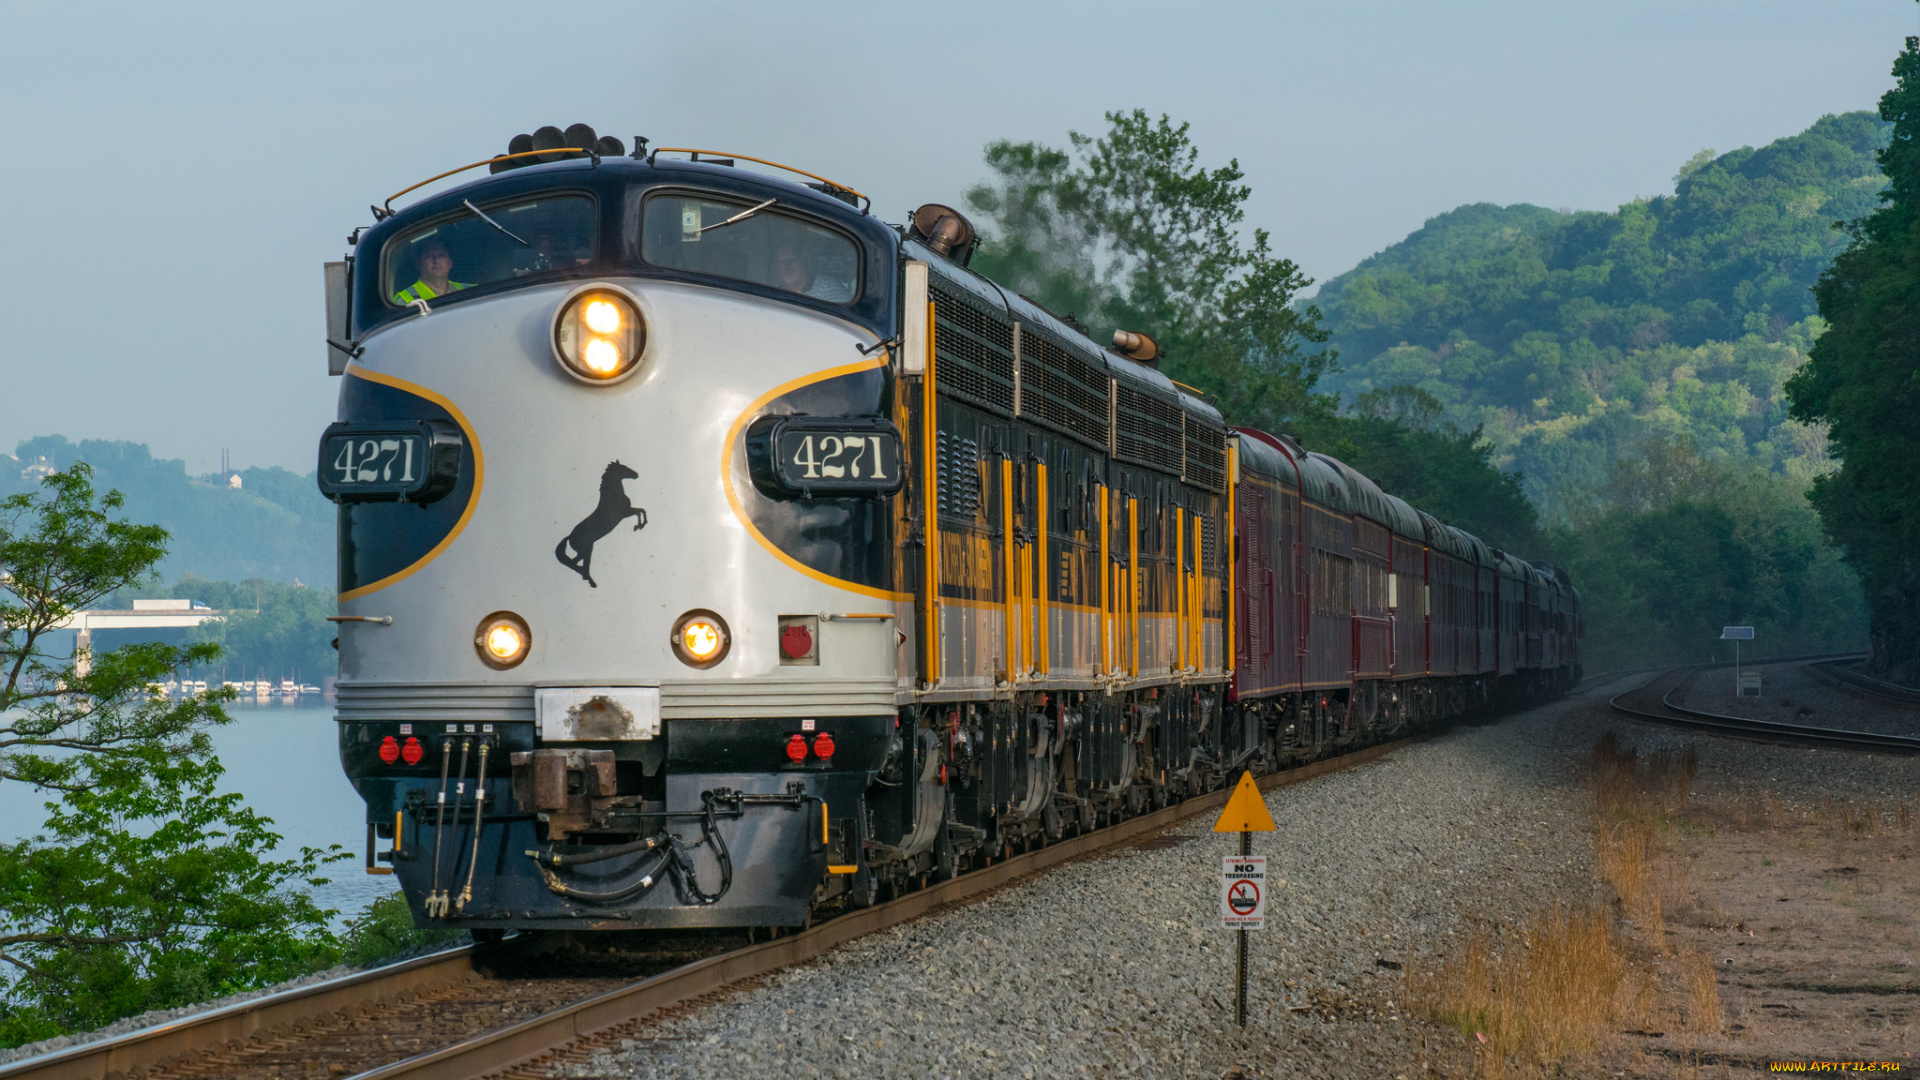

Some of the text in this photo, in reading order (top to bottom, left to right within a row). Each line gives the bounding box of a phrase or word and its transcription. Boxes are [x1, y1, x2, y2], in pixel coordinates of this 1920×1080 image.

[334, 439, 415, 483] 4271
[793, 435, 888, 479] 4271
[1234, 864, 1254, 872] NO
